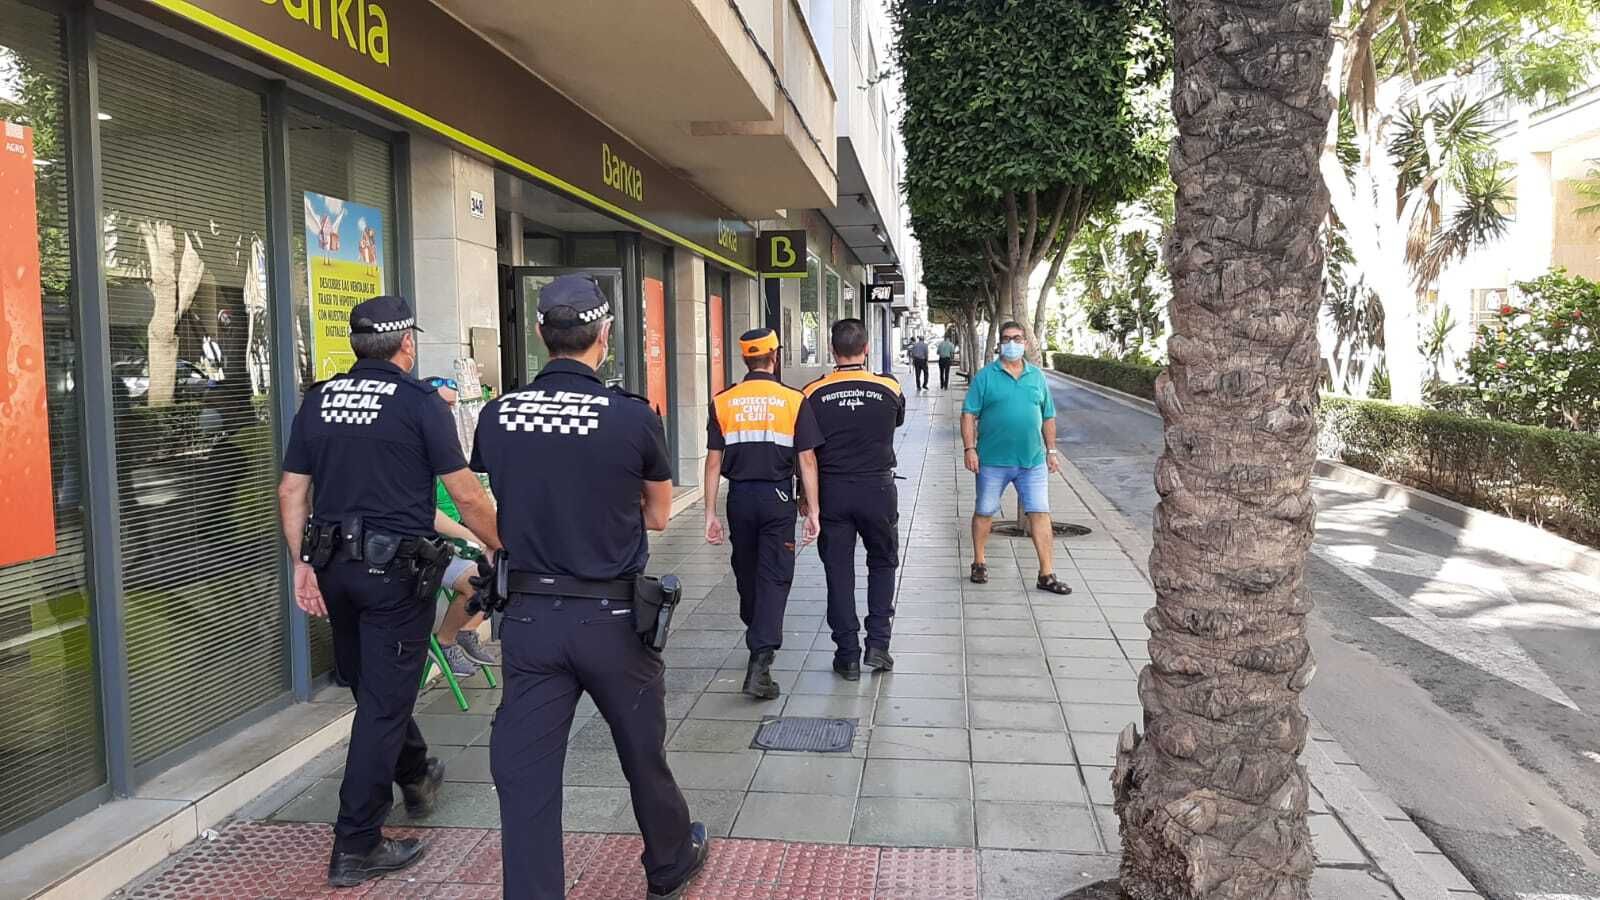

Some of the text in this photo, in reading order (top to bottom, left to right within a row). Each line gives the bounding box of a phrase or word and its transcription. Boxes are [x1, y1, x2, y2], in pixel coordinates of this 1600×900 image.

[602, 143, 643, 201] Bankia
[771, 235, 797, 268] B
[321, 378, 398, 396] POLICIA
[821, 388, 884, 403] PROTECCIÓN CIVIL
[321, 393, 383, 410] LOCAL
[498, 390, 609, 406] POLICIA
[498, 401, 599, 417] LOCAL
